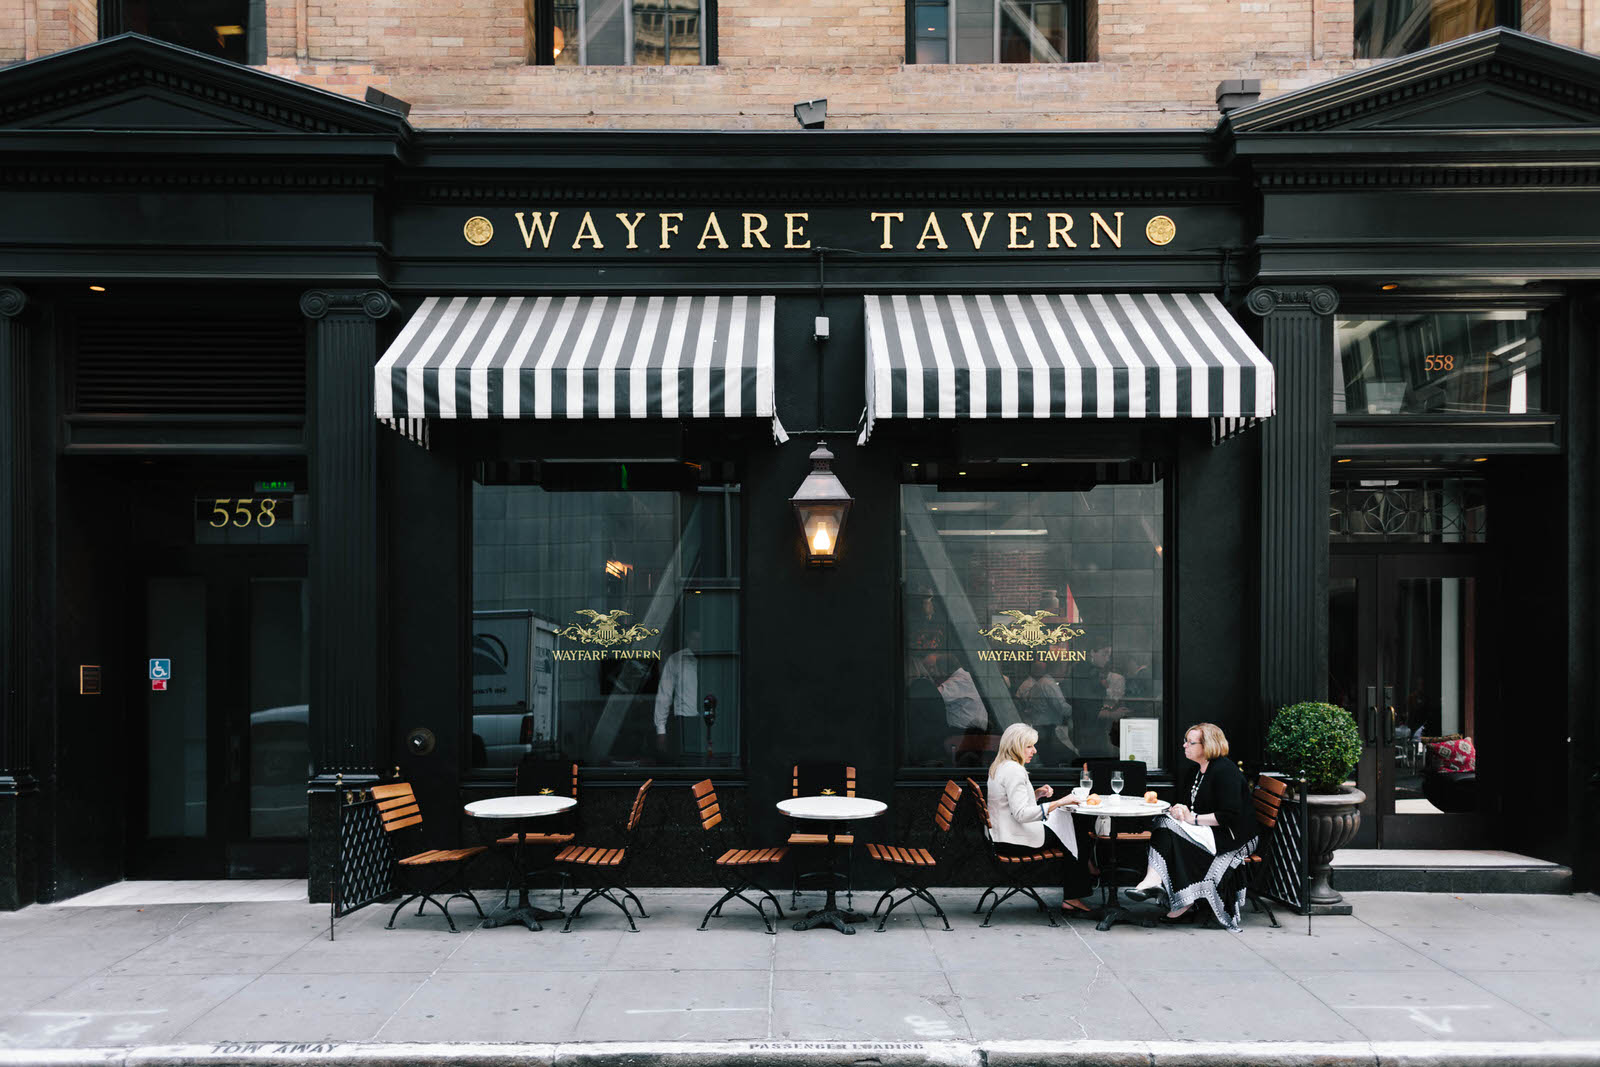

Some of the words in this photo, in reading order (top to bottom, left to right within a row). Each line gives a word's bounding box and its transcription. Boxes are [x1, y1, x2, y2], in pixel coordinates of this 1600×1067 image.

[514, 211, 812, 250] WAYFARE
[870, 211, 1125, 250] TAVERN
[1424, 354, 1454, 371] 558
[209, 498, 276, 528] 558
[552, 649, 608, 661] WAYFARE
[612, 649, 661, 661] TAVERN
[977, 650, 1034, 662] WAYFARE
[1037, 650, 1087, 662] TAVERN
[211, 1044, 264, 1054] TOW
[272, 1044, 339, 1054] AWAY
